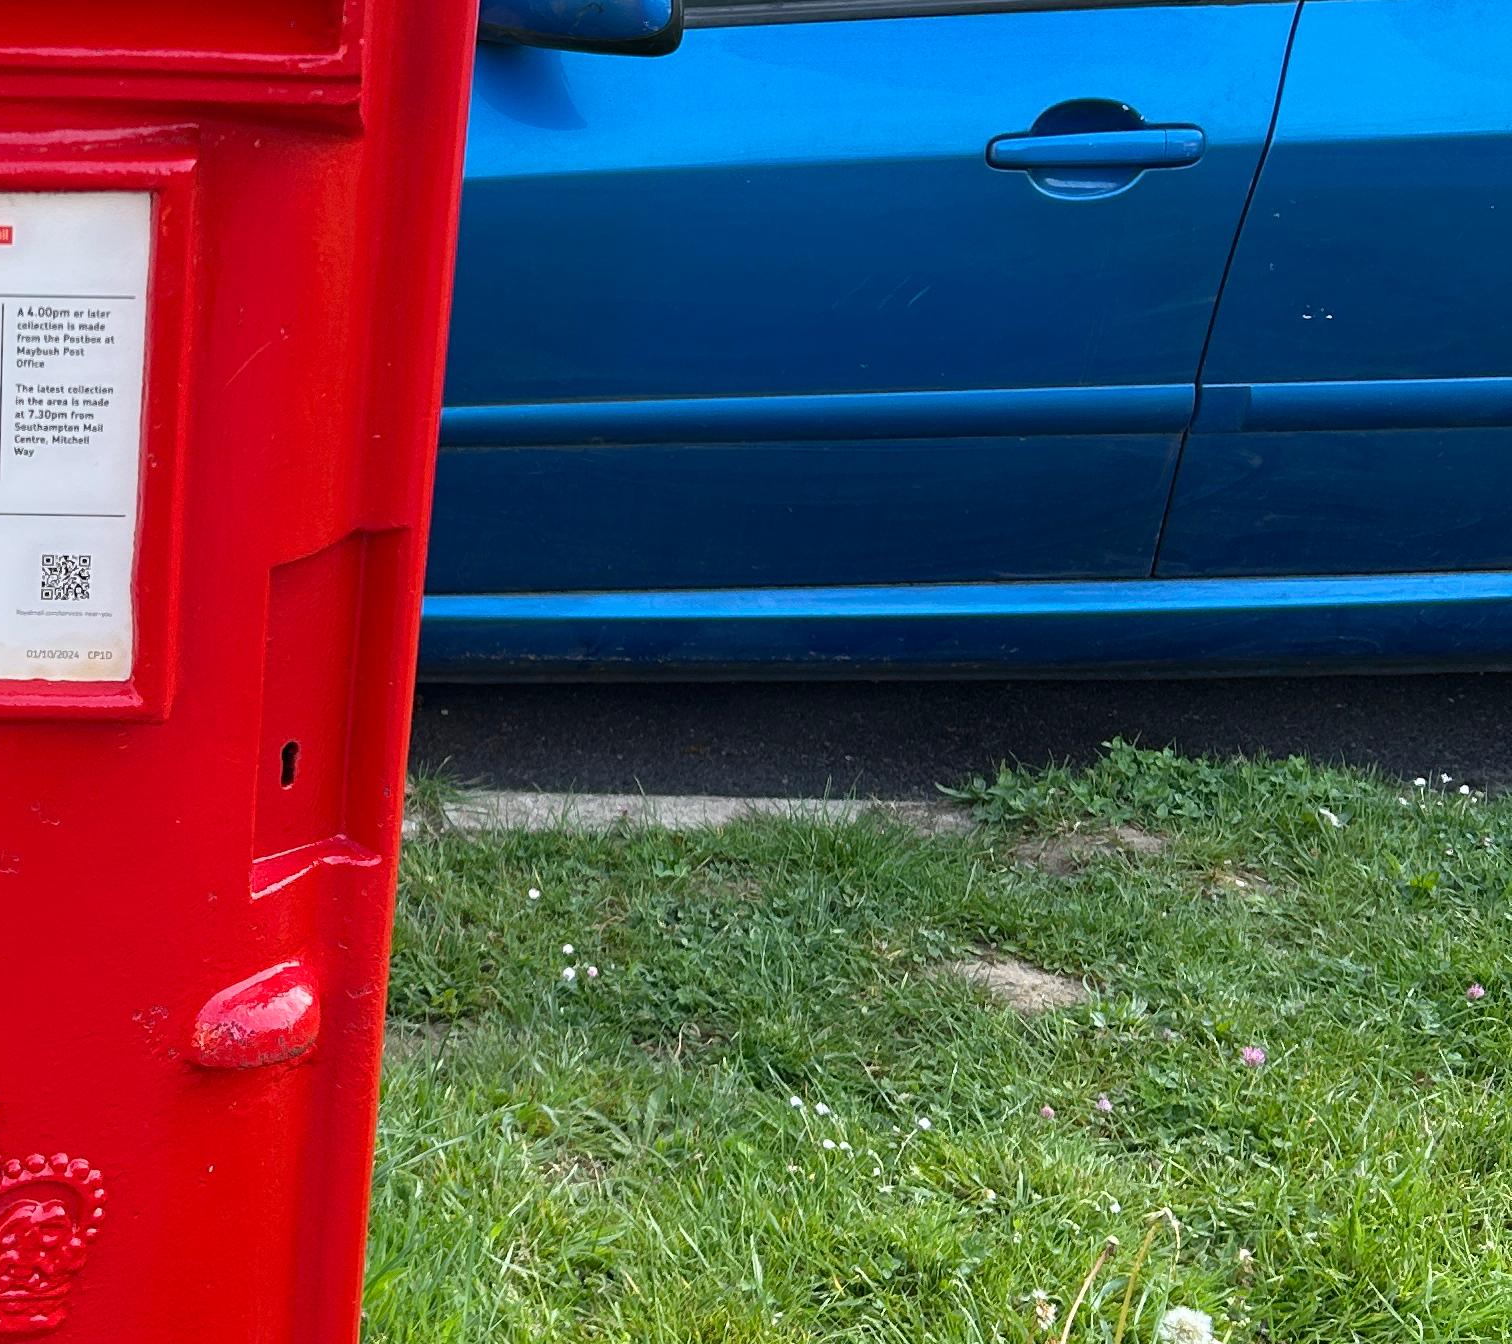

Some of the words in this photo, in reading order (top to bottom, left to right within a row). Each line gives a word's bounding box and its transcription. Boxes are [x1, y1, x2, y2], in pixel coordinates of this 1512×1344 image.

[17, 307, 24, 318] A
[73, 310, 84, 318] or
[87, 308, 111, 319] later
[17, 321, 64, 331] collection
[67, 322, 75, 331] is
[78, 321, 106, 331] made
[16, 333, 41, 343] from
[43, 334, 60, 344] the
[63, 333, 102, 344] Postbox
[105, 335, 115, 344] at
[16, 346, 60, 357] Maybush
[63, 347, 85, 357] Post
[16, 359, 45, 368] Office
[15, 383, 34, 394] The
[37, 384, 64, 394] latest
[67, 384, 114, 395] collection
[15, 396, 24, 406] in
[27, 397, 44, 406] the
[46, 398, 68, 406] area
[71, 397, 80, 407] is
[82, 397, 110, 407] made
[14, 410, 24, 419] at
[28, 409, 68, 421] 7.30pm
[70, 410, 95, 420] from
[14, 422, 80, 433] Southampton
[83, 423, 104, 433] Mail
[14, 434, 48, 445] Centre,
[52, 435, 90, 445] Mitchell
[13, 446, 35, 457] Way
